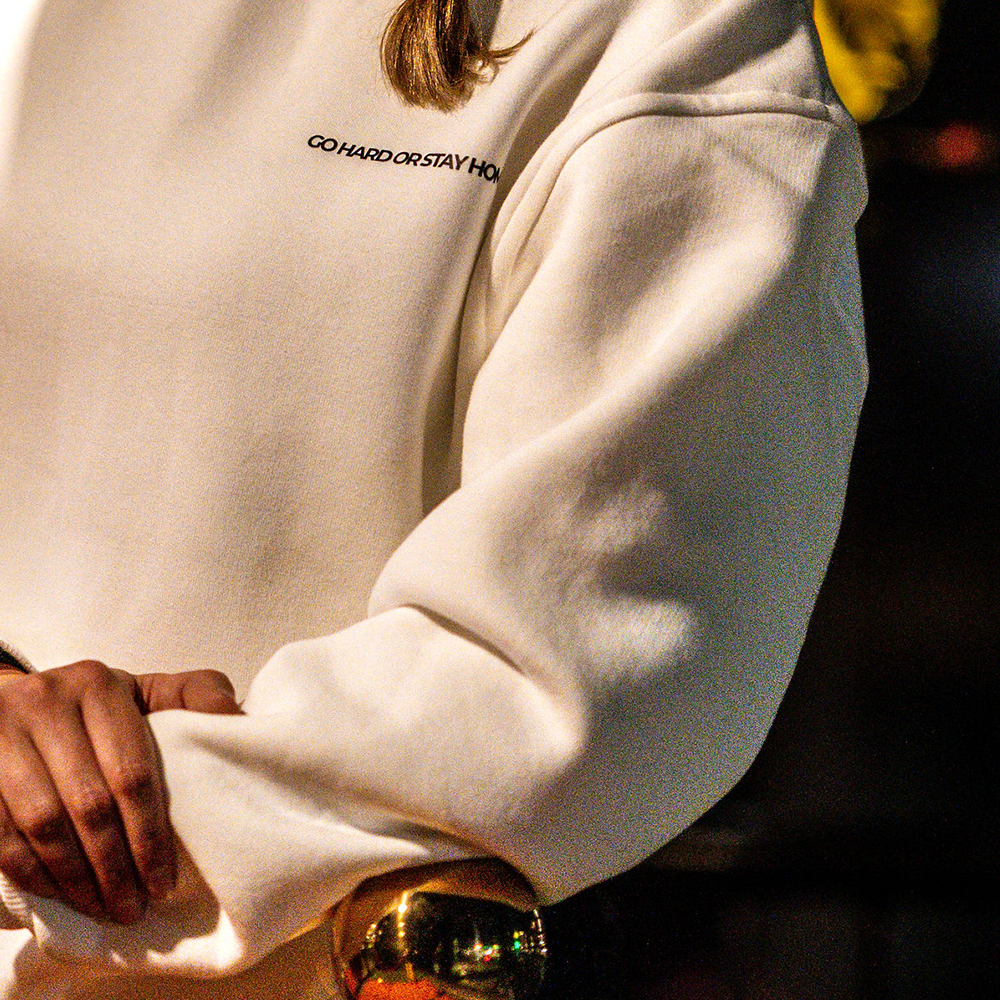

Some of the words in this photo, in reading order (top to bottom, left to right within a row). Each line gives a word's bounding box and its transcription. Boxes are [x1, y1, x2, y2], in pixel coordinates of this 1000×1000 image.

[307, 134, 338, 152] GO
[336, 142, 394, 162] HARD
[392, 151, 422, 167] OR
[420, 152, 469, 171] STAY
